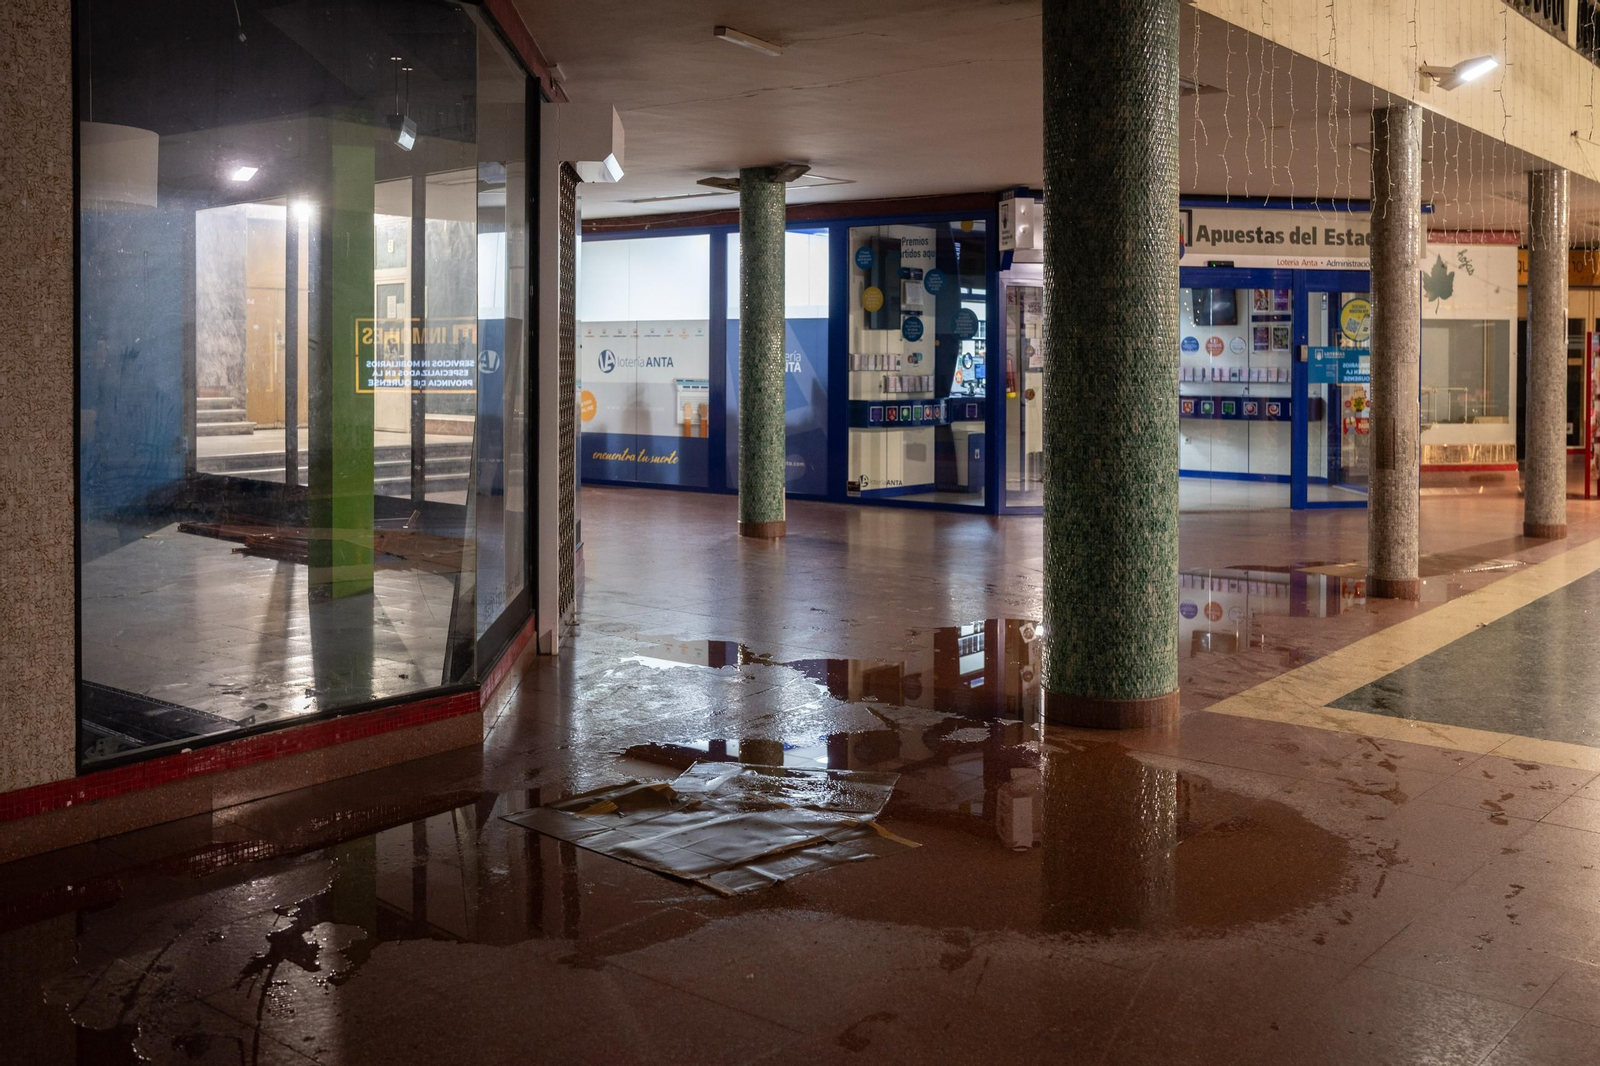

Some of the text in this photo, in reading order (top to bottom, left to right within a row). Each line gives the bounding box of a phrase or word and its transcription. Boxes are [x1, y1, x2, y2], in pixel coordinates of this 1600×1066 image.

[1195, 225, 1371, 246] Apuestas del Esta
[901, 237, 929, 246] Premios
[922, 250, 936, 260] aqu
[1301, 258, 1319, 267] Anta
[1326, 259, 1371, 268] Administració
[785, 350, 802, 361] ería
[592, 448, 679, 464] encuentra tu suerte
